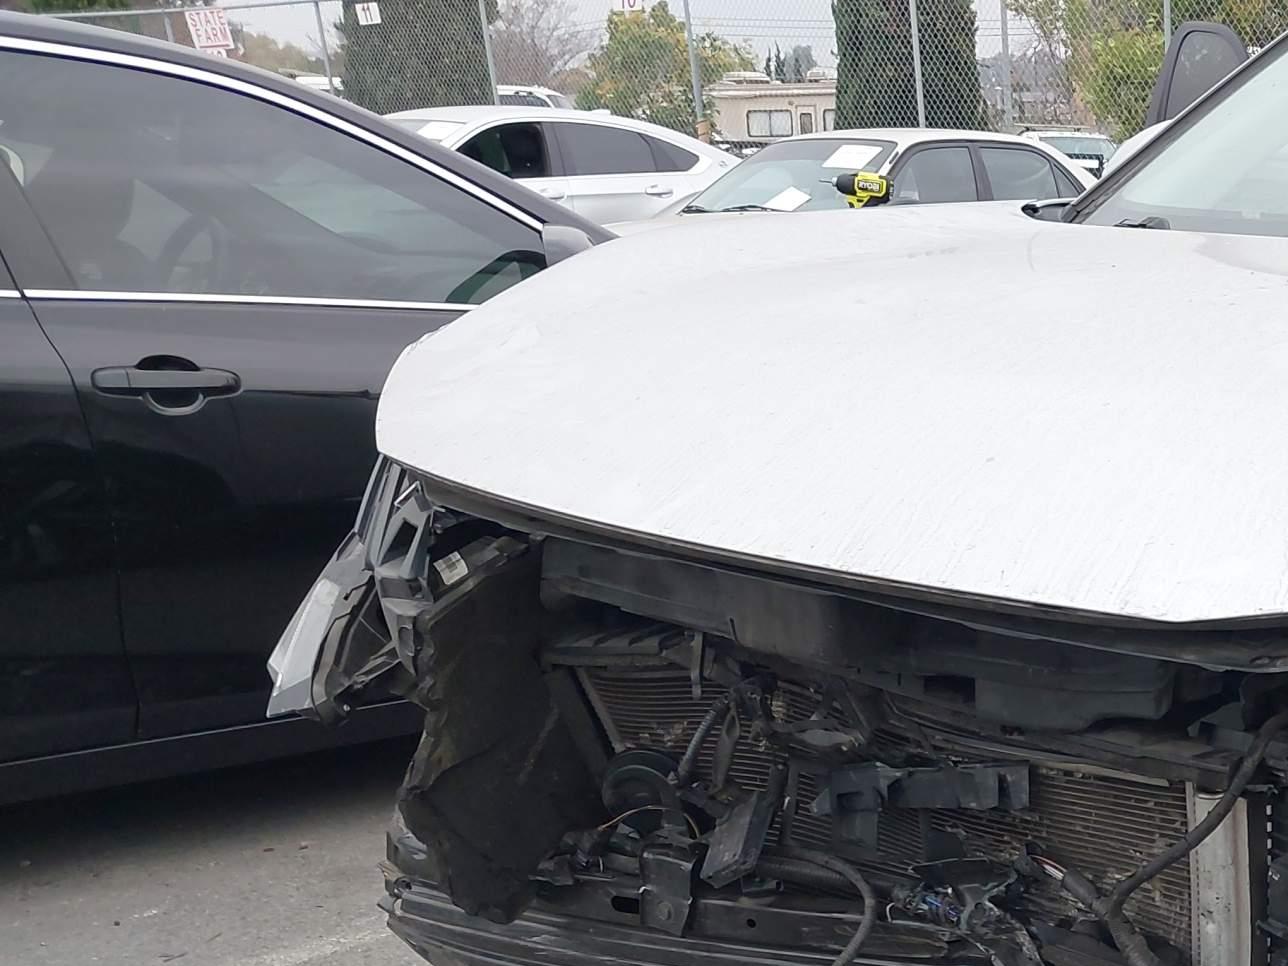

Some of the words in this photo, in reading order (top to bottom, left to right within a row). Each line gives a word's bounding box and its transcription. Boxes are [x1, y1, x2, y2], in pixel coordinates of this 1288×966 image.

[188, 10, 226, 28] STATE
[361, 4, 374, 23] 11
[194, 27, 230, 43] FARM
